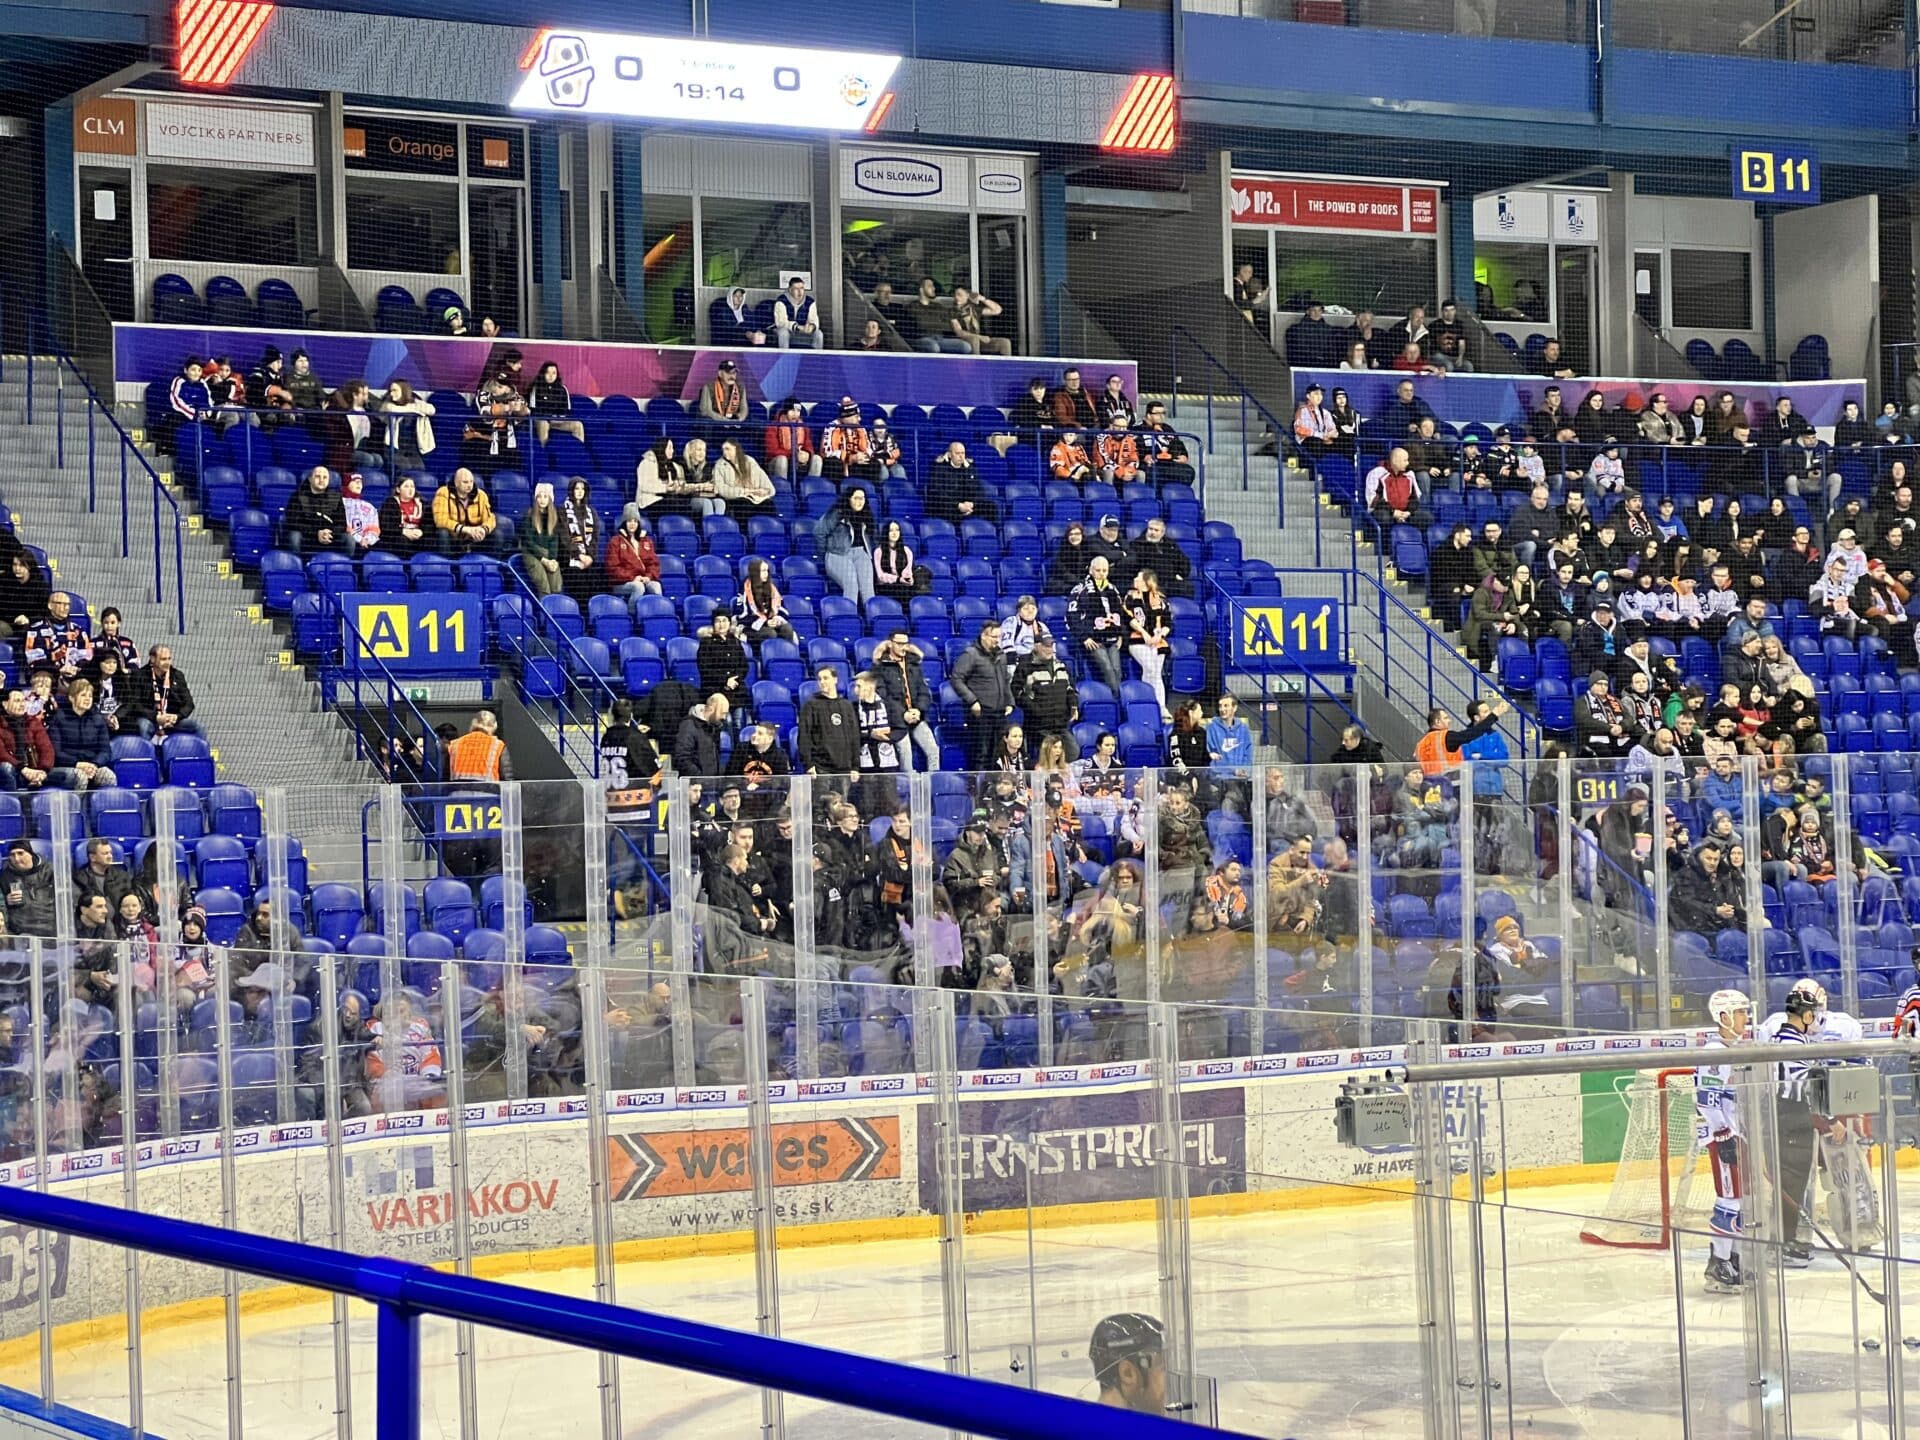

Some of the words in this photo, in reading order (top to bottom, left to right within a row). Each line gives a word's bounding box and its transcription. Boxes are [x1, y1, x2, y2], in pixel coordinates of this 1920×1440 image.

[615, 55, 643, 81] 0
[773, 66, 800, 91] 0
[673, 82, 745, 100] 19:14
[83, 117, 124, 136] CLM
[389, 136, 454, 160] Orange
[864, 170, 884, 180] CLN
[887, 171, 934, 183] SLOVAKIA
[1308, 200, 1324, 212] THE
[1326, 201, 1356, 214] POWER
[1359, 203, 1368, 214] OF
[1371, 204, 1398, 216] ROOFS
[365, 611, 403, 652] A
[419, 609, 465, 653] 11
[1291, 612, 1328, 651] 11
[1460, 1046, 1490, 1057] TIPOS
[1513, 1044, 1545, 1055] TIPOS
[1308, 1055, 1338, 1066] TIPOS
[1361, 1051, 1391, 1062] TIPOS
[1103, 1066, 1136, 1077] TIPOS
[1206, 1063, 1232, 1074] TIPOS
[1254, 1060, 1286, 1071] TIPOS
[986, 1074, 1020, 1084] TIPOS
[1048, 1071, 1077, 1081] TIPOS
[812, 1083, 845, 1094] TIPOS
[873, 1079, 903, 1090] TIPOS
[630, 1093, 663, 1105] TIPOS
[690, 1091, 725, 1102] TIPOS
[388, 1116, 421, 1129] TIPOS
[283, 1127, 312, 1140] TIPOS
[72, 1155, 101, 1169] TIPOS
[677, 1134, 829, 1180] waes
[1378, 1158, 1414, 1174] HAVE
[446, 1218, 529, 1241] PODUCTS
